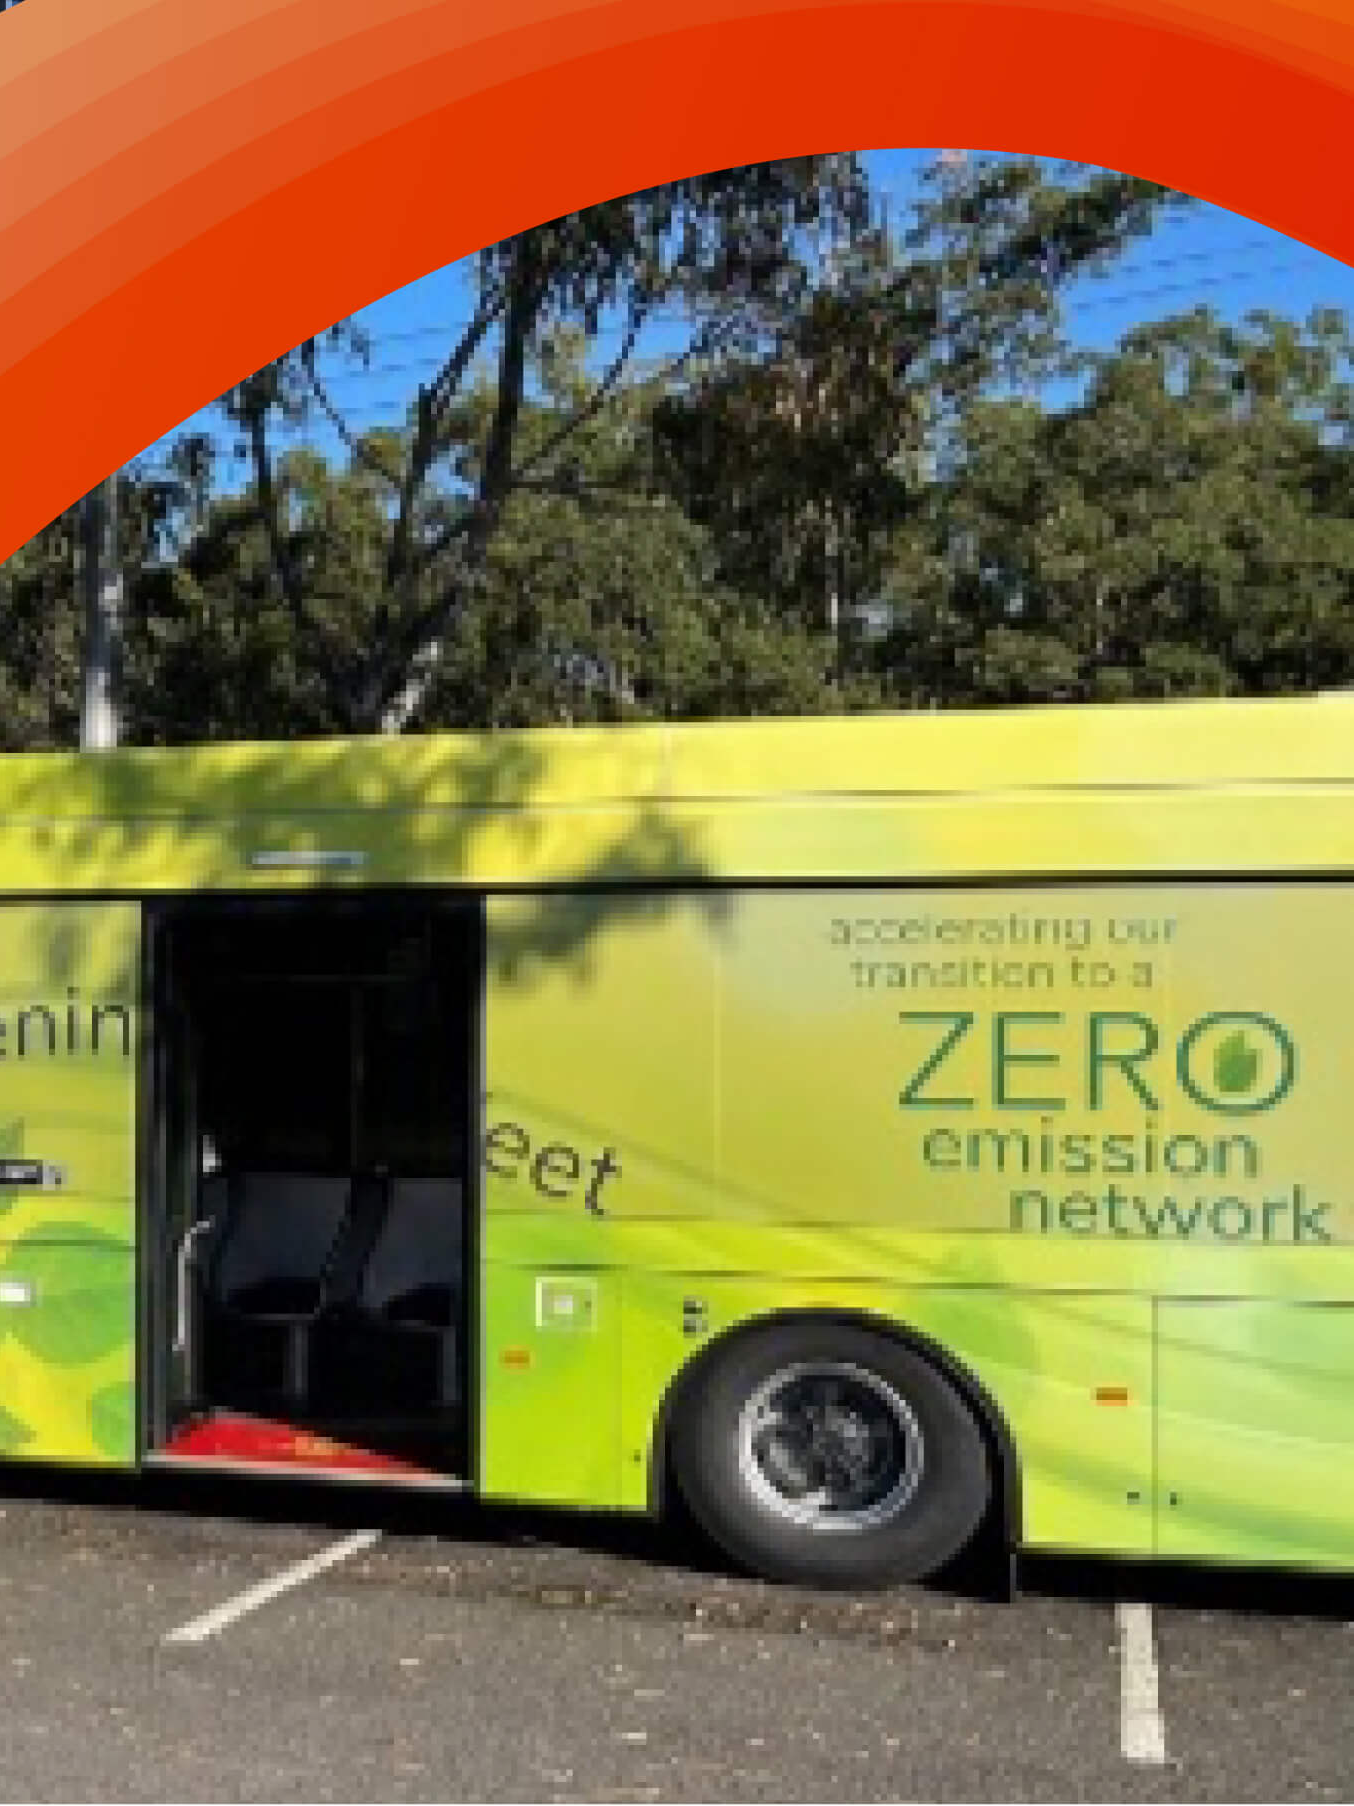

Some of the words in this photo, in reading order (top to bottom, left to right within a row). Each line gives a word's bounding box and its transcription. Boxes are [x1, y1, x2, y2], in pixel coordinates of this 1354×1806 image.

[828, 913, 1091, 950] accelerating
[1108, 918, 1178, 944] our
[850, 956, 1054, 987] transition
[1071, 956, 1116, 987] to
[1128, 961, 1154, 987] a
[898, 1010, 1298, 1117] ZERO
[922, 1115, 1263, 1179] emission
[1009, 1183, 1332, 1244] network
